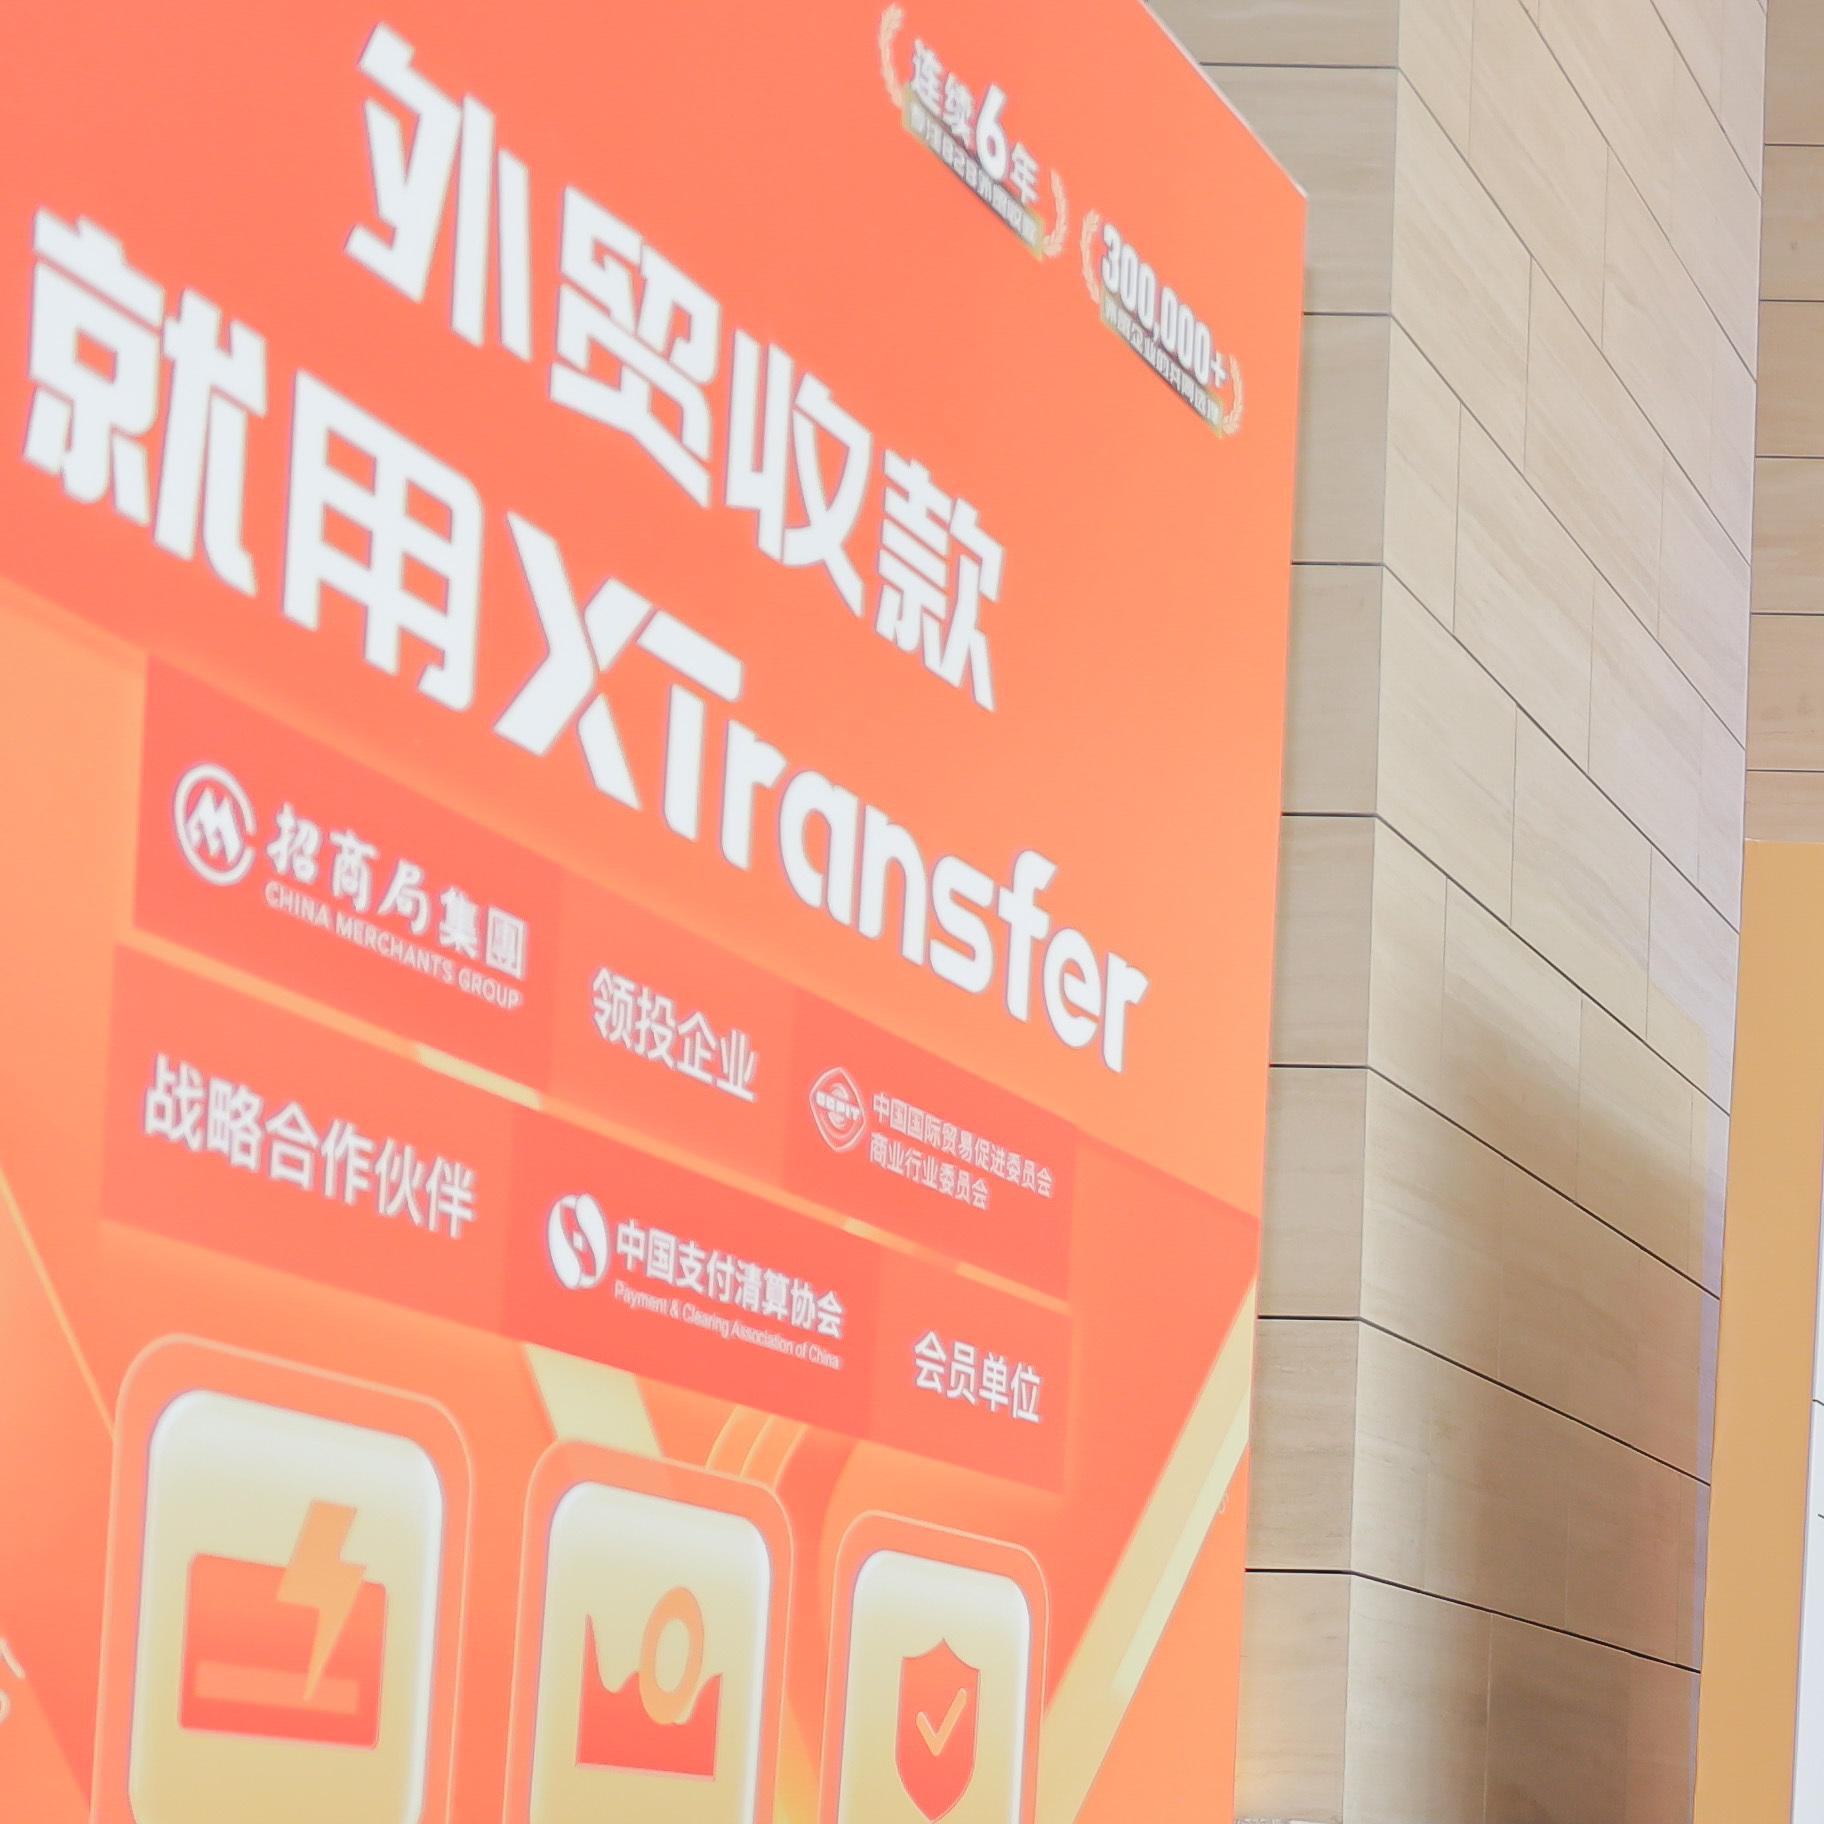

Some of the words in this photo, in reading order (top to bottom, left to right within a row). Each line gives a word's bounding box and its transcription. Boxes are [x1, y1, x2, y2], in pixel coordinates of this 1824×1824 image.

[911, 37, 1040, 203] 连续6年
[345, 23, 1004, 712] 外贸收款
[1102, 222, 1227, 389] 300,000+
[264, 880, 331, 932] CHINA
[335, 911, 454, 985] MERCHANTS
[457, 967, 523, 1010] GROUP
[267, 801, 528, 981] 招商局集團
[592, 966, 758, 1102] 领投企业
[144, 1053, 477, 1239] 战略合作伙伴
[869, 1131, 989, 1211] 商业行业委员会
[872, 1092, 1053, 1198] 中国国际贸易促进委员会
[613, 1281, 667, 1318] Payment
[682, 1302, 730, 1339] Clearing
[730, 1319, 795, 1358] Association
[808, 1341, 841, 1370] China
[615, 1219, 844, 1340] 中国支付清算协会
[914, 1330, 1043, 1424] 会员单位
